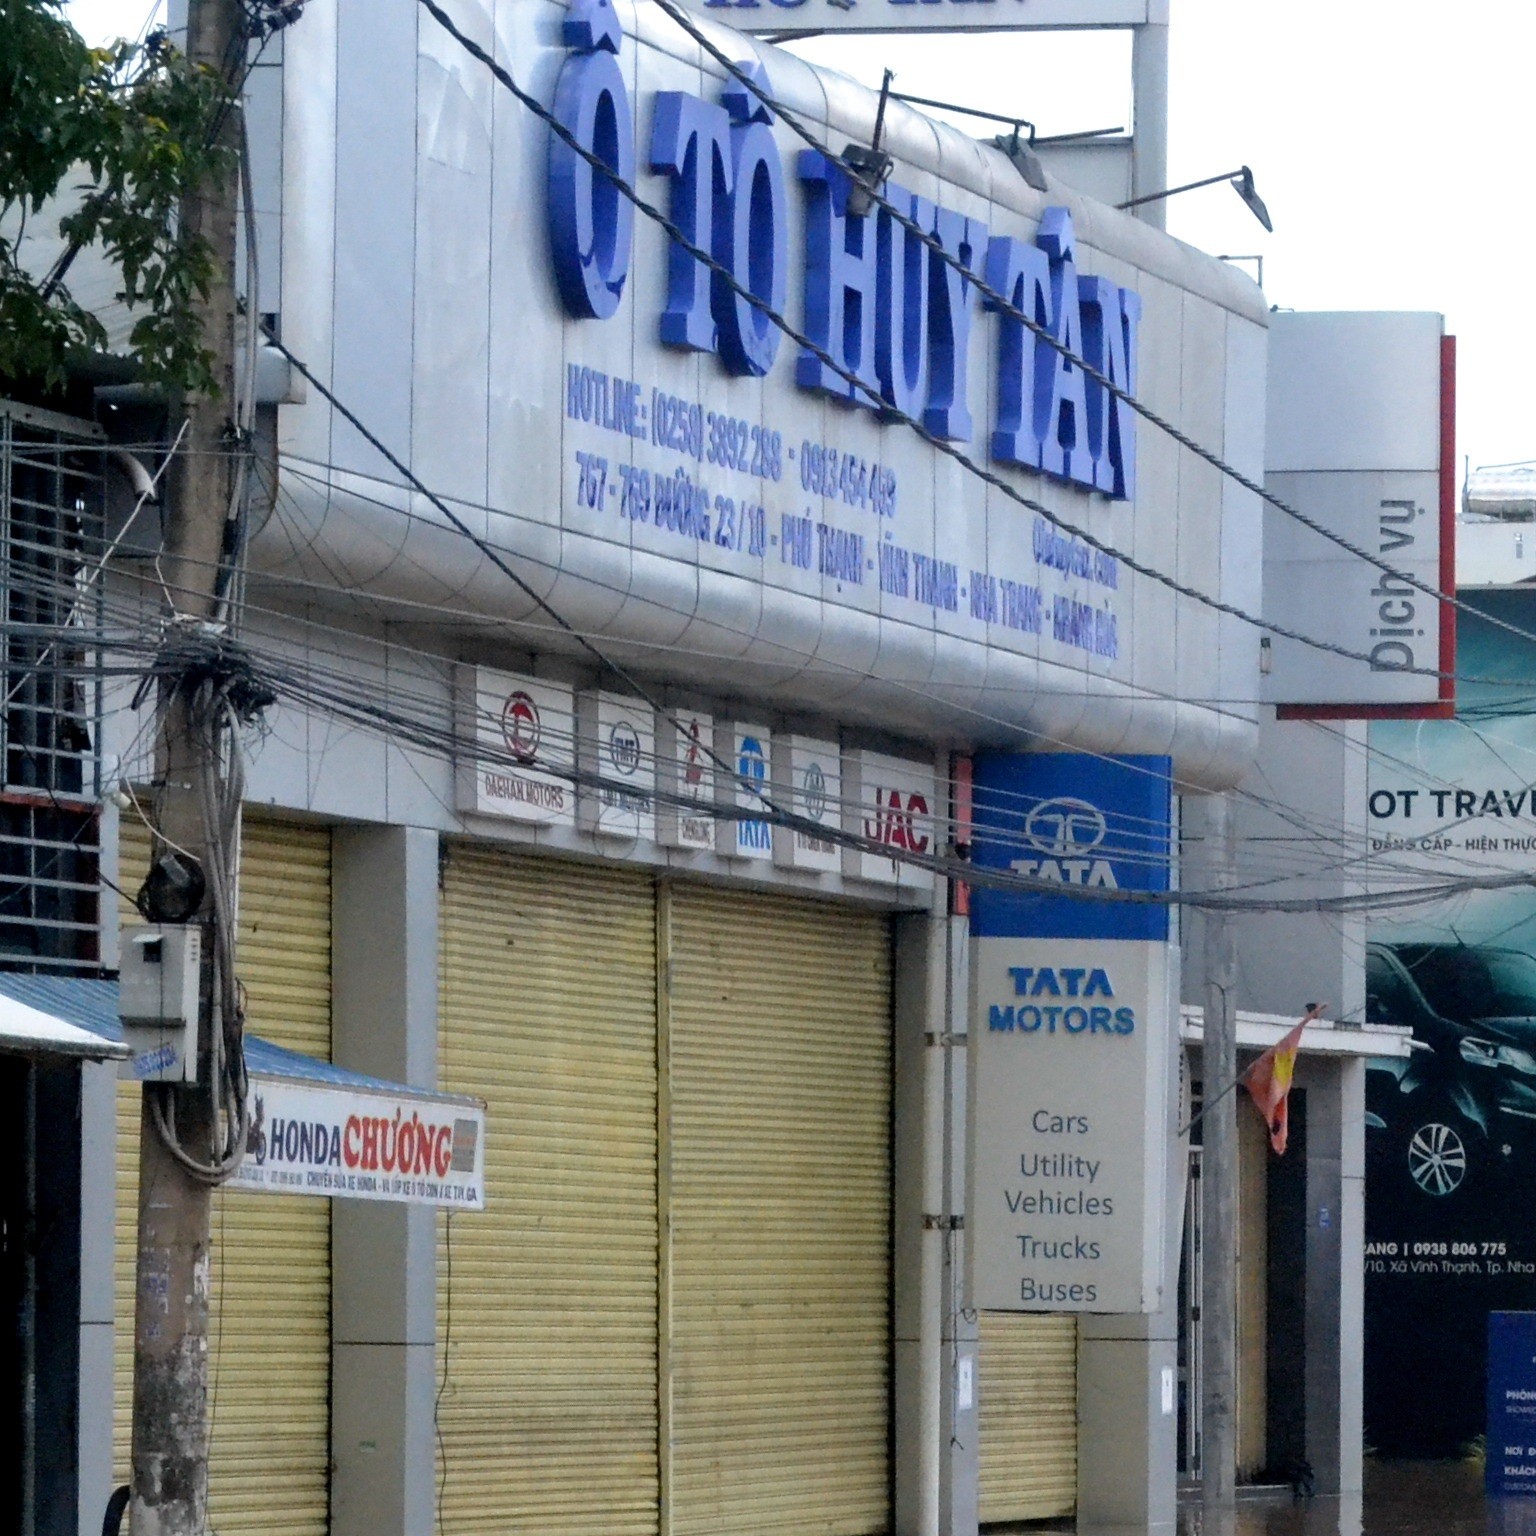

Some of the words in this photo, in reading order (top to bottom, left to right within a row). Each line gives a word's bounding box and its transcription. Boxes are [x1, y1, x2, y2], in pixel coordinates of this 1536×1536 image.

[650, 60, 788, 377] TÔ
[796, 149, 988, 443] HUY
[984, 207, 1141, 501] TÂN
[567, 362, 647, 440] HOTLINE:
[707, 411, 750, 473] 3892
[751, 424, 783, 483] 288
[576, 450, 609, 512] 767
[619, 462, 650, 523] 769
[714, 495, 736, 551] 23
[749, 504, 766, 558] 10
[781, 507, 812, 570] PHÚ
[1379, 500, 1426, 553] vụ
[1370, 573, 1426, 672] Dịch
[526, 783, 564, 809] MOTORS
[865, 786, 929, 855] JAC
[1421, 834, 1453, 851] CẤP
[1465, 835, 1499, 853] HIỆN
[1008, 966, 1114, 998] TATA
[988, 1004, 1135, 1037] MOTORS
[1032, 1108, 1089, 1135] Cars
[270, 1117, 341, 1167] HONDA
[344, 1107, 452, 1178] CHƯƠNG
[1020, 1152, 1100, 1183] Utility
[1005, 1189, 1114, 1217] Vehicles
[1017, 1234, 1101, 1261] Trucks
[1413, 1243, 1448, 1256] 0938
[1451, 1243, 1477, 1256] 806
[1481, 1243, 1507, 1256] 775
[1411, 1260, 1438, 1273] Vĩnh
[1508, 1261, 1534, 1273] Nha
[1020, 1277, 1097, 1303] Buses
